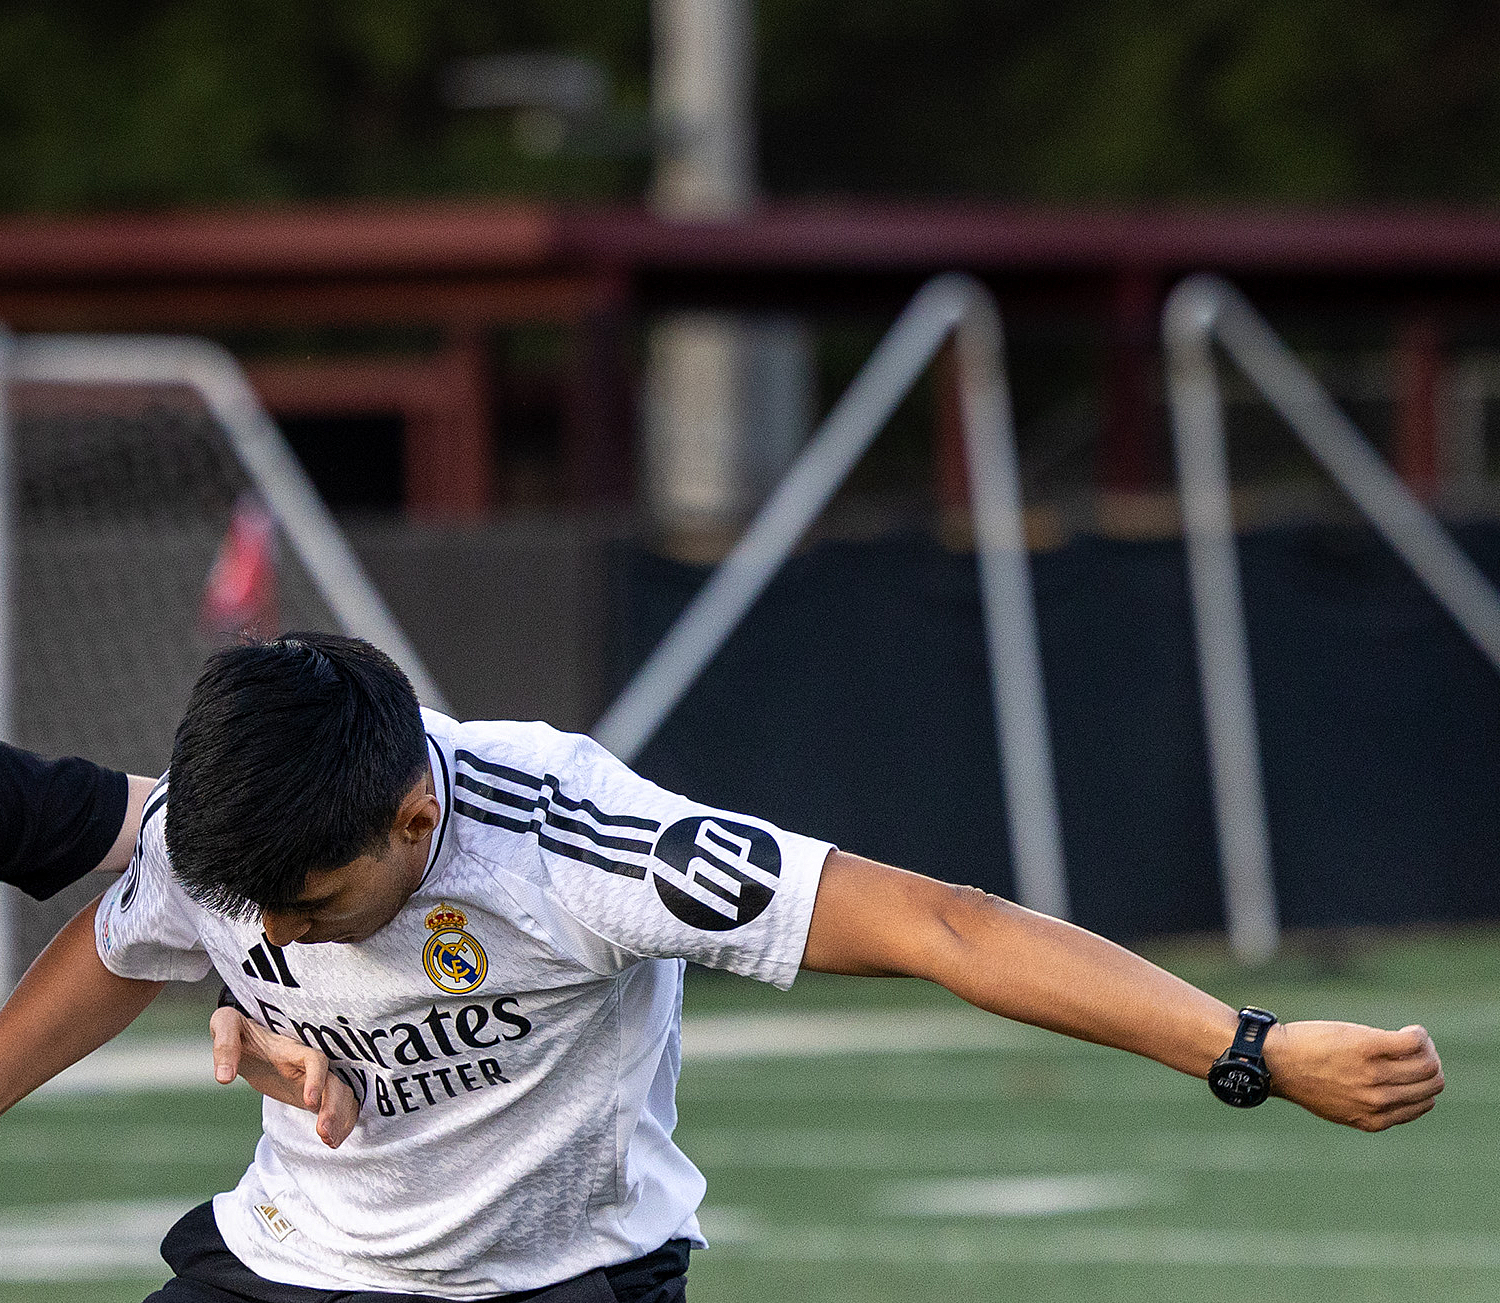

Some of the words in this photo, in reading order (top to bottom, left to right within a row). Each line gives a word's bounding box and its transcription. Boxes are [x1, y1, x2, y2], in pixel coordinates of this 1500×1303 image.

[653, 819, 781, 922] hp
[255, 996, 532, 1069] Emirates
[376, 1057, 511, 1118] BETTER
